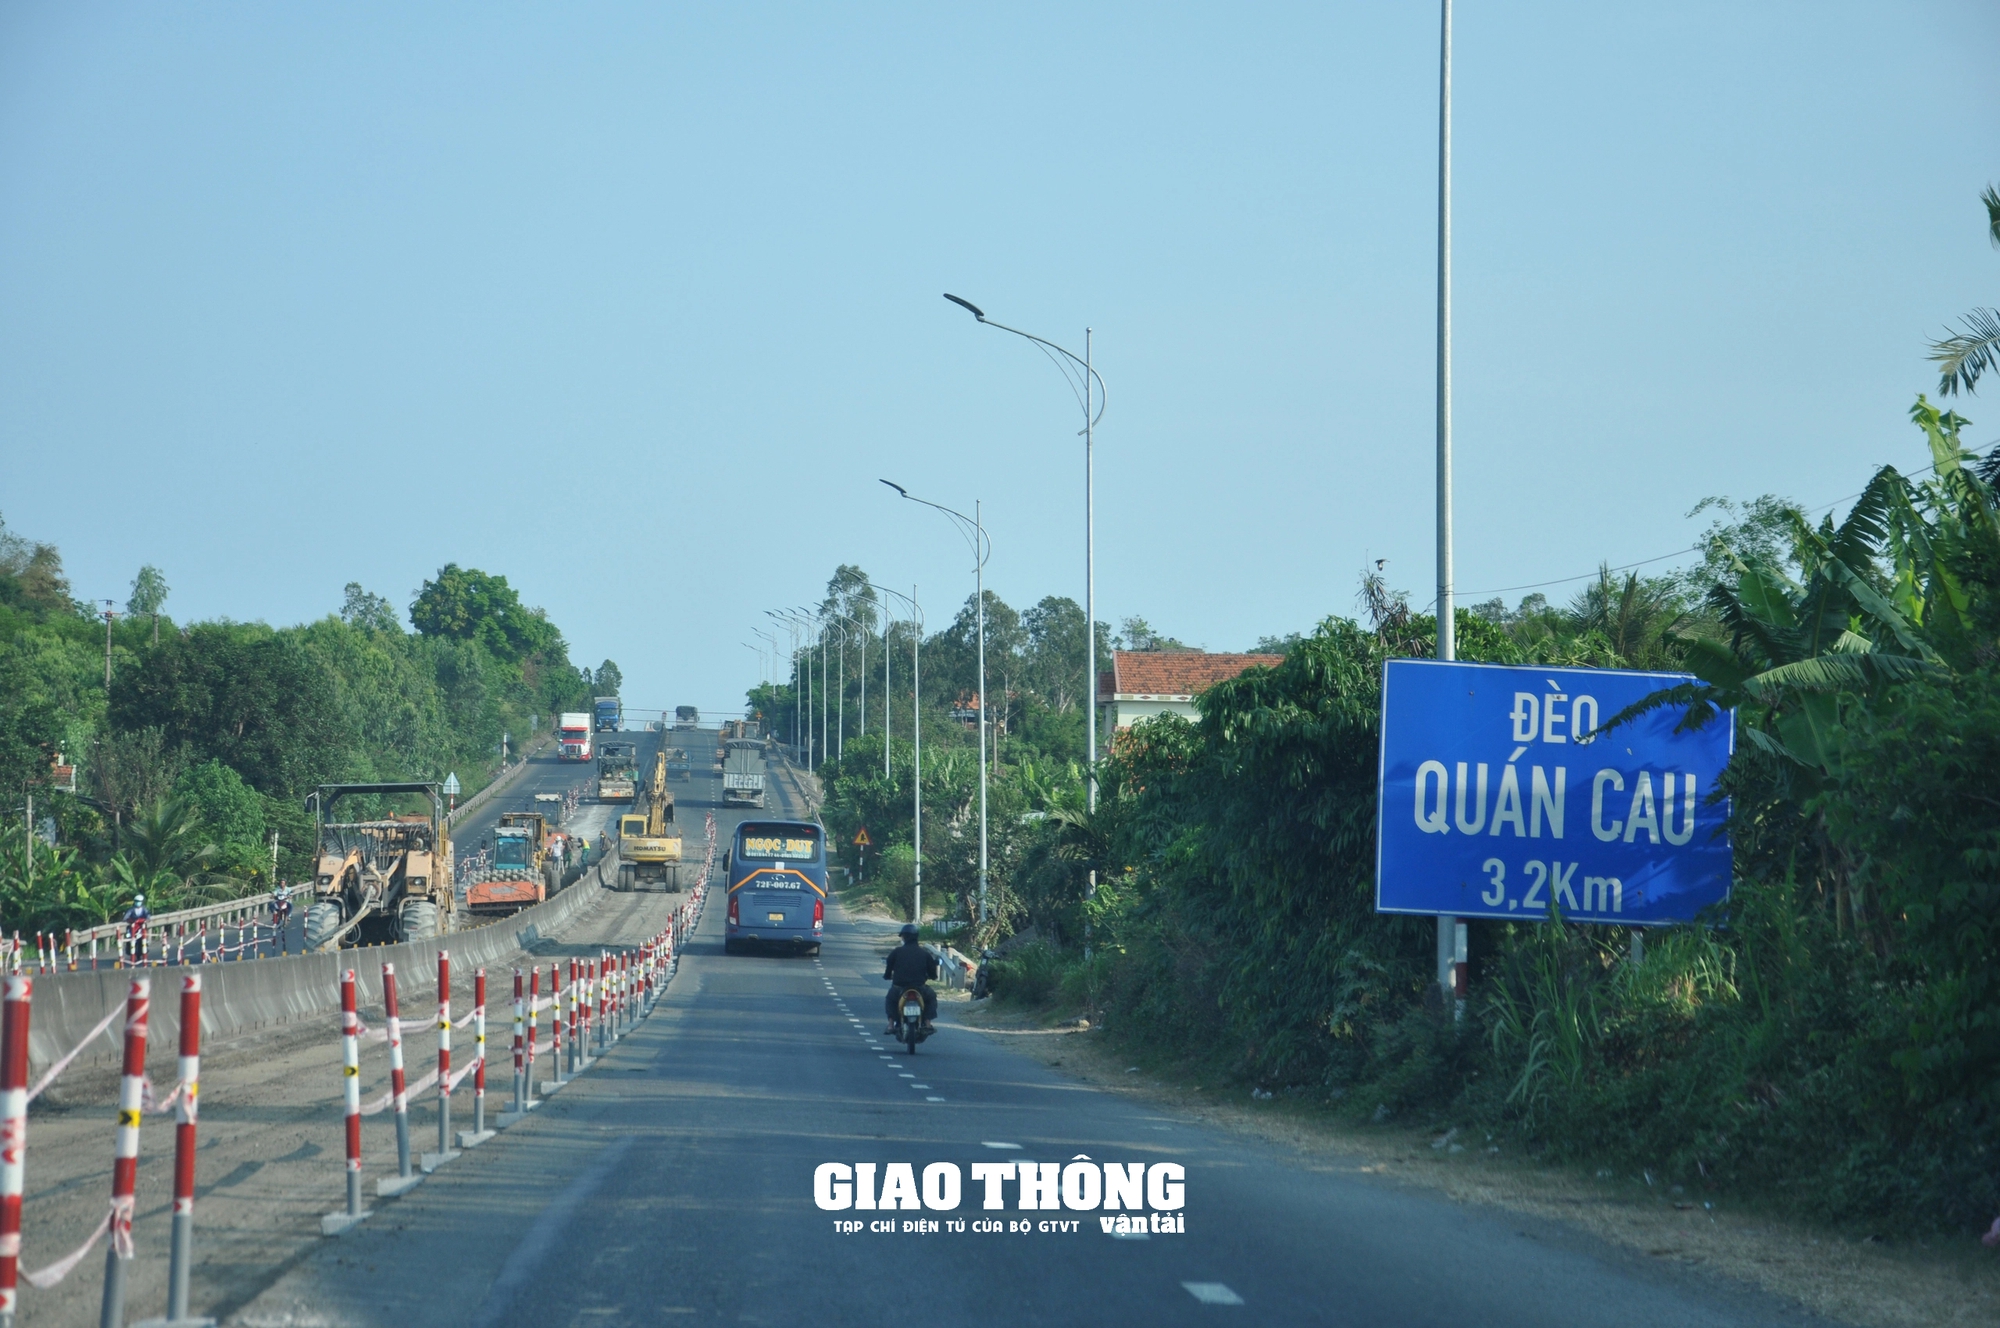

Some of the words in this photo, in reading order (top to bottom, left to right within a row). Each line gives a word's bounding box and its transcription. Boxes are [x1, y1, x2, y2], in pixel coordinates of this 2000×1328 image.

[1509, 679, 1599, 745] ĐÈO
[1414, 746, 1567, 839] QUÁN
[1591, 768, 1697, 846] CAU
[745, 838, 781, 853] NGỌC
[786, 838, 813, 852] DUY
[756, 880, 801, 889] 72F-007.67
[1481, 857, 1622, 913] 3,2Km
